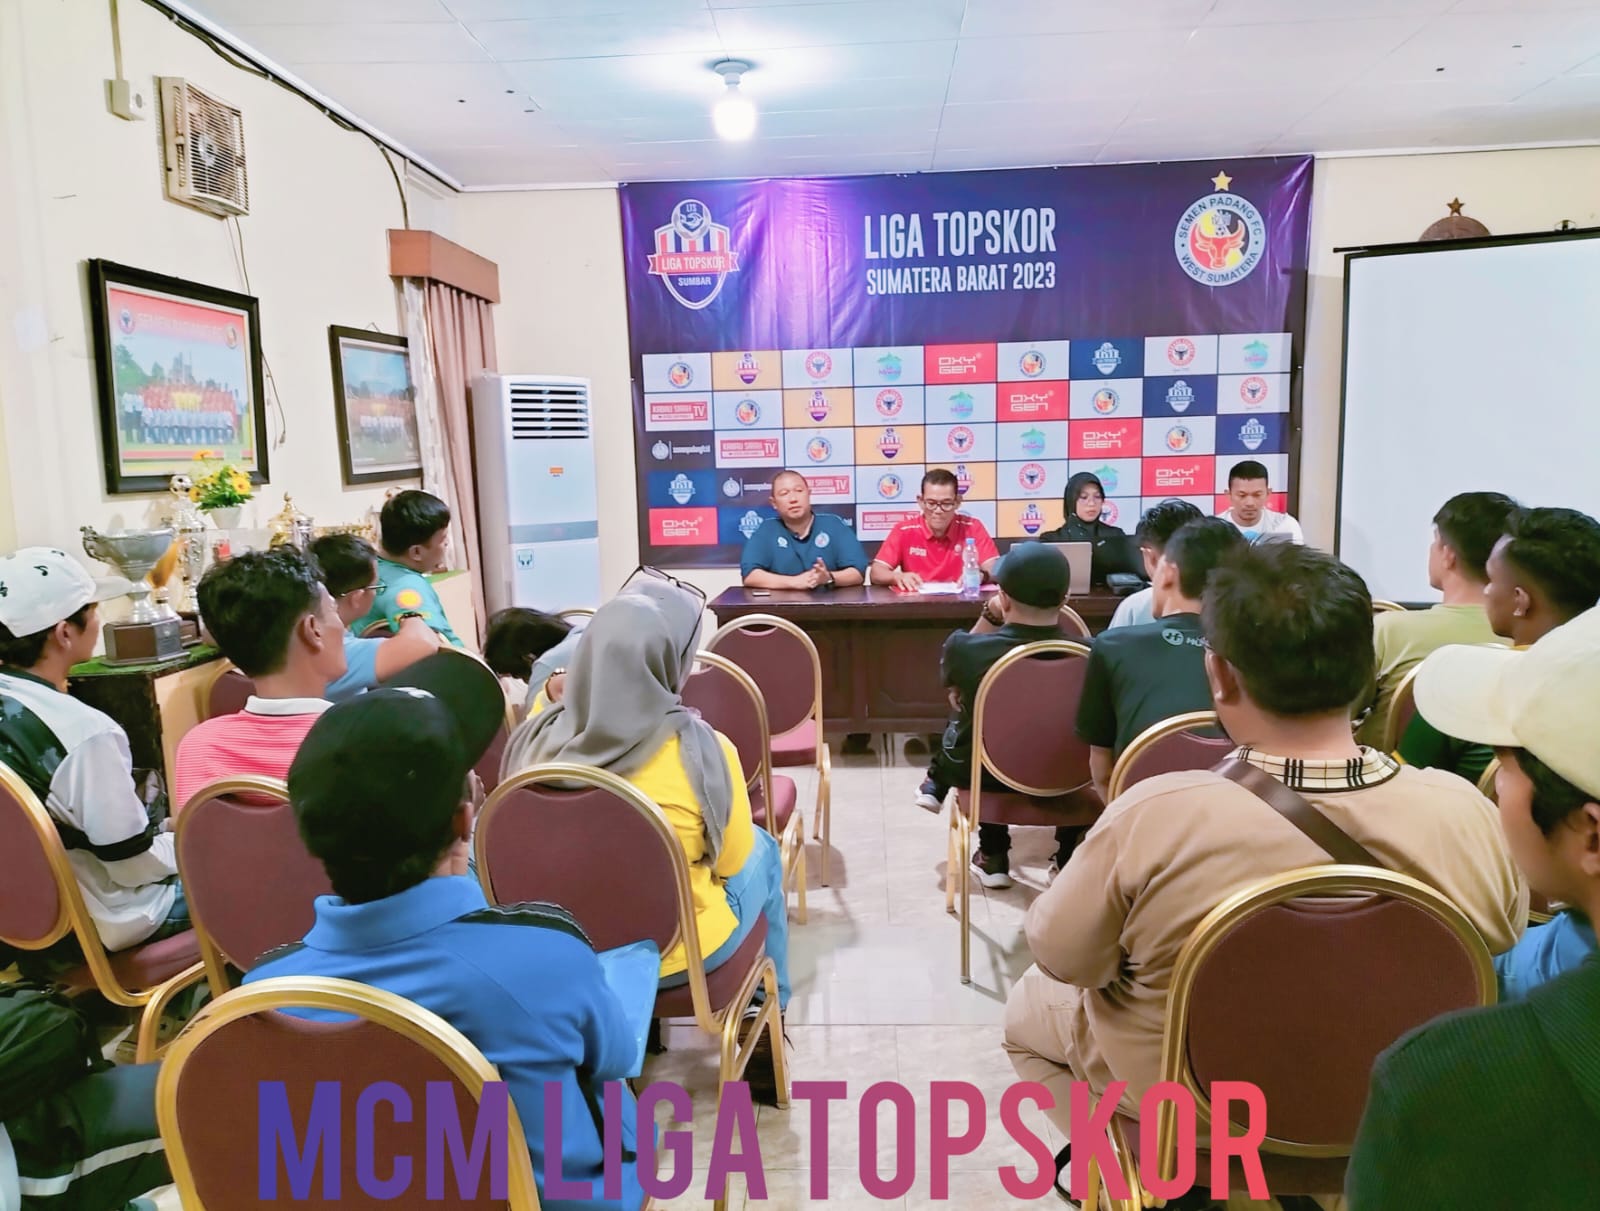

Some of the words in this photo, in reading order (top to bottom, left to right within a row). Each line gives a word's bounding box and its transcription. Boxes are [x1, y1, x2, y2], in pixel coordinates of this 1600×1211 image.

[1179, 201, 1207, 238] SEMEN
[1209, 197, 1255, 220] PADANG
[1251, 220, 1262, 235] FC
[864, 212, 925, 260] LIGA
[932, 207, 1057, 257] TOPSKOR
[661, 257, 682, 271] LIGA
[683, 255, 726, 270] TOPSKOR
[1182, 254, 1206, 278] WEST
[1206, 252, 1259, 283] SUMATERA
[677, 276, 712, 287] SUMBAR
[866, 266, 952, 296] SUMATERA
[956, 264, 1008, 292] BARAT
[1012, 261, 1056, 290] 2023
[692, 405, 705, 417] TV
[763, 442, 777, 454] TV
[834, 479, 847, 490] TV
